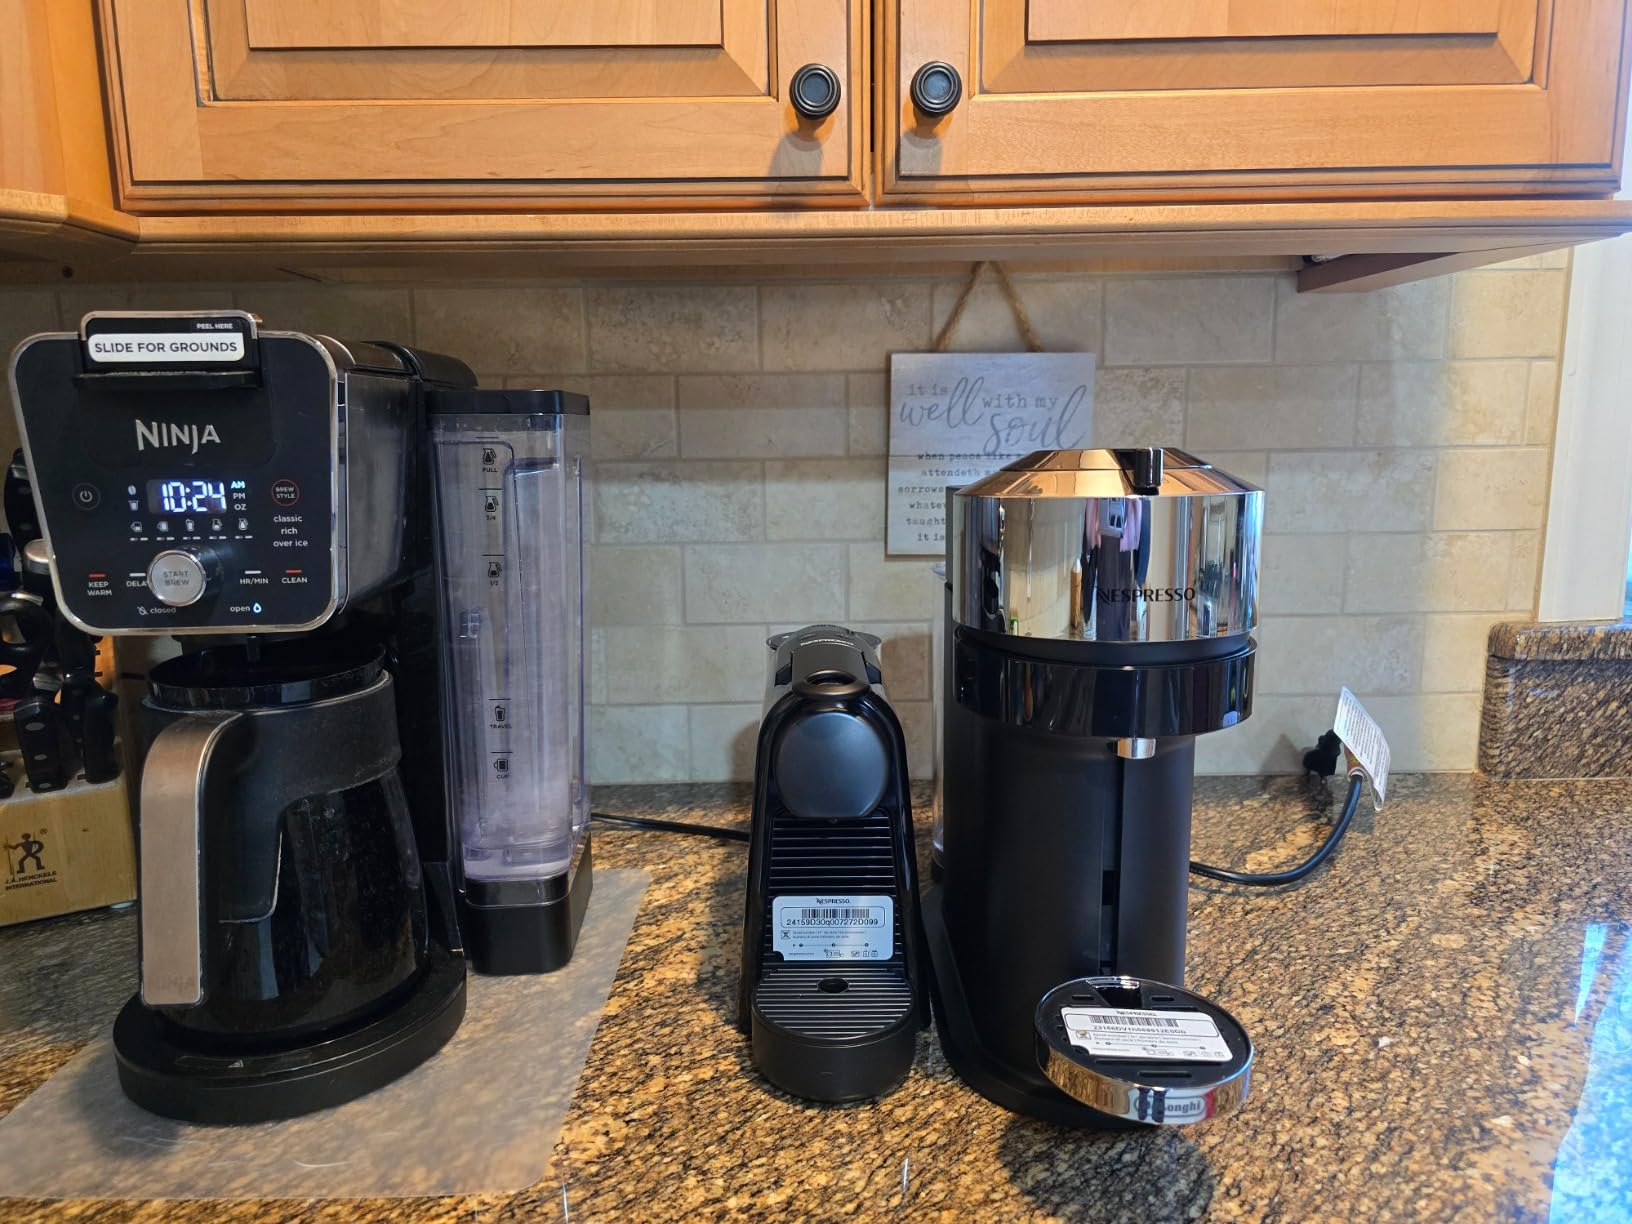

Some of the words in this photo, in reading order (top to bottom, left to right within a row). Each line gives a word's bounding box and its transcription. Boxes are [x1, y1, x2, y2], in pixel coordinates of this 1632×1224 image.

[196, 322, 214, 330] PEEL
[215, 322, 233, 330] HERE
[94, 342, 134, 354] SLIDE
[137, 342, 166, 353] FOR
[169, 341, 238, 353] GROUNDS
[908, 383, 924, 397] it
[900, 375, 986, 430] well
[982, 392, 1028, 409] with
[1034, 397, 1058, 411] my
[983, 384, 1088, 456] soul
[135, 418, 221, 455] NINJA
[230, 480, 246, 490] AM
[160, 480, 228, 512] 10:24
[232, 492, 246, 500] PM
[234, 503, 247, 511] OZ
[273, 514, 303, 523] classic
[280, 526, 298, 535] rich
[273, 540, 293, 548] over
[295, 539, 309, 548] ice
[162, 571, 189, 579] START
[88, 581, 109, 589] KEEP
[125, 580, 148, 588] DELA
[164, 579, 190, 587] BREW
[239, 577, 269, 586] HR/MIN
[281, 576, 308, 585] CLEAN
[87, 589, 113, 597] WARM
[1096, 587, 1196, 604] NESPRESSO
[149, 606, 177, 615] closed
[229, 605, 251, 614] open
